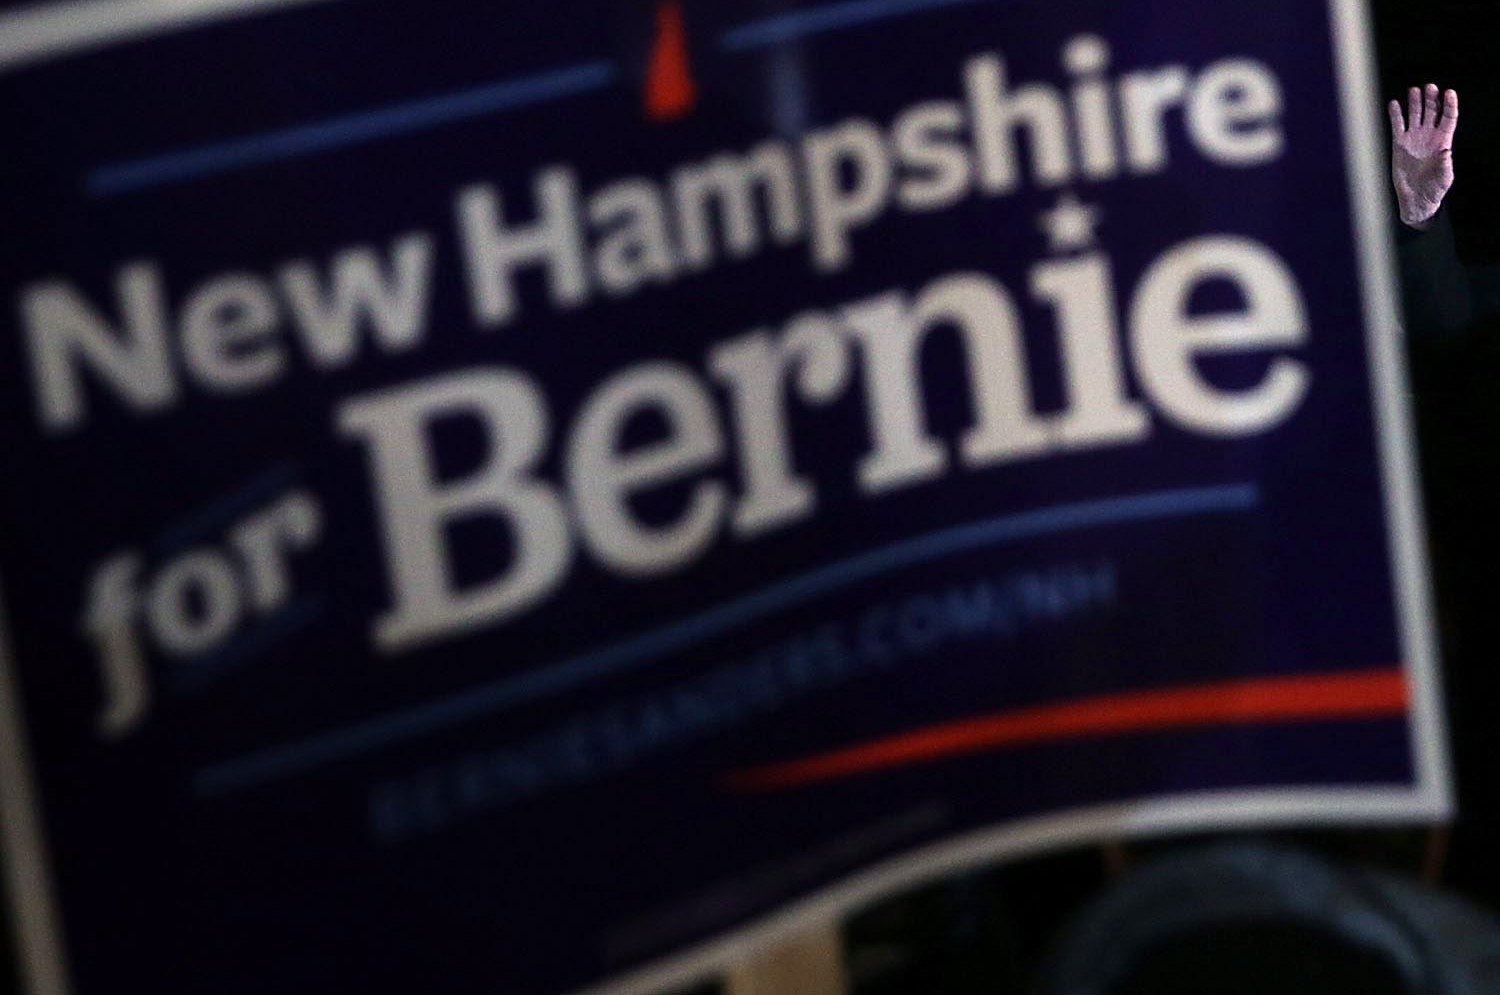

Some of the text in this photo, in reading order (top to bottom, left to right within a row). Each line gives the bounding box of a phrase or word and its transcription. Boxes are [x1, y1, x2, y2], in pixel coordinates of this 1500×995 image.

[16, 30, 1288, 440] New Hampshire
[74, 196, 1313, 743] for Bernie
